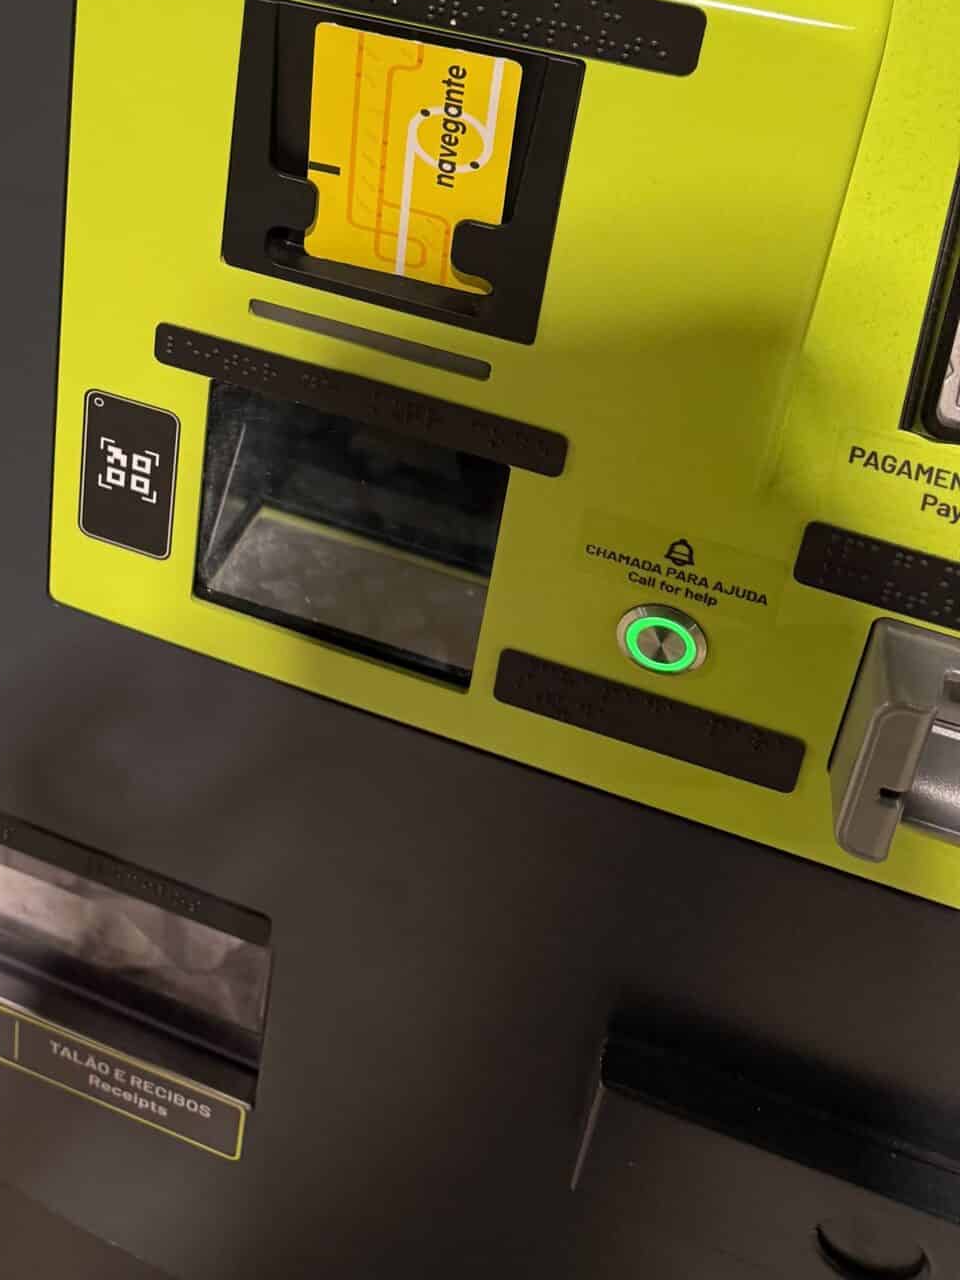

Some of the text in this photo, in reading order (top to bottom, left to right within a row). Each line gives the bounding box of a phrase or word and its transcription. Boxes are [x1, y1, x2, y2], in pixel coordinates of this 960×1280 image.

[436, 64, 468, 189] navegante
[585, 543, 768, 606] CHAMADA PARA AJUDA
[627, 571, 718, 607] Call for help
[88, 1073, 168, 1118] Receipts
[113, 1068, 127, 1083] E
[130, 1074, 212, 1119] RECIBOS
